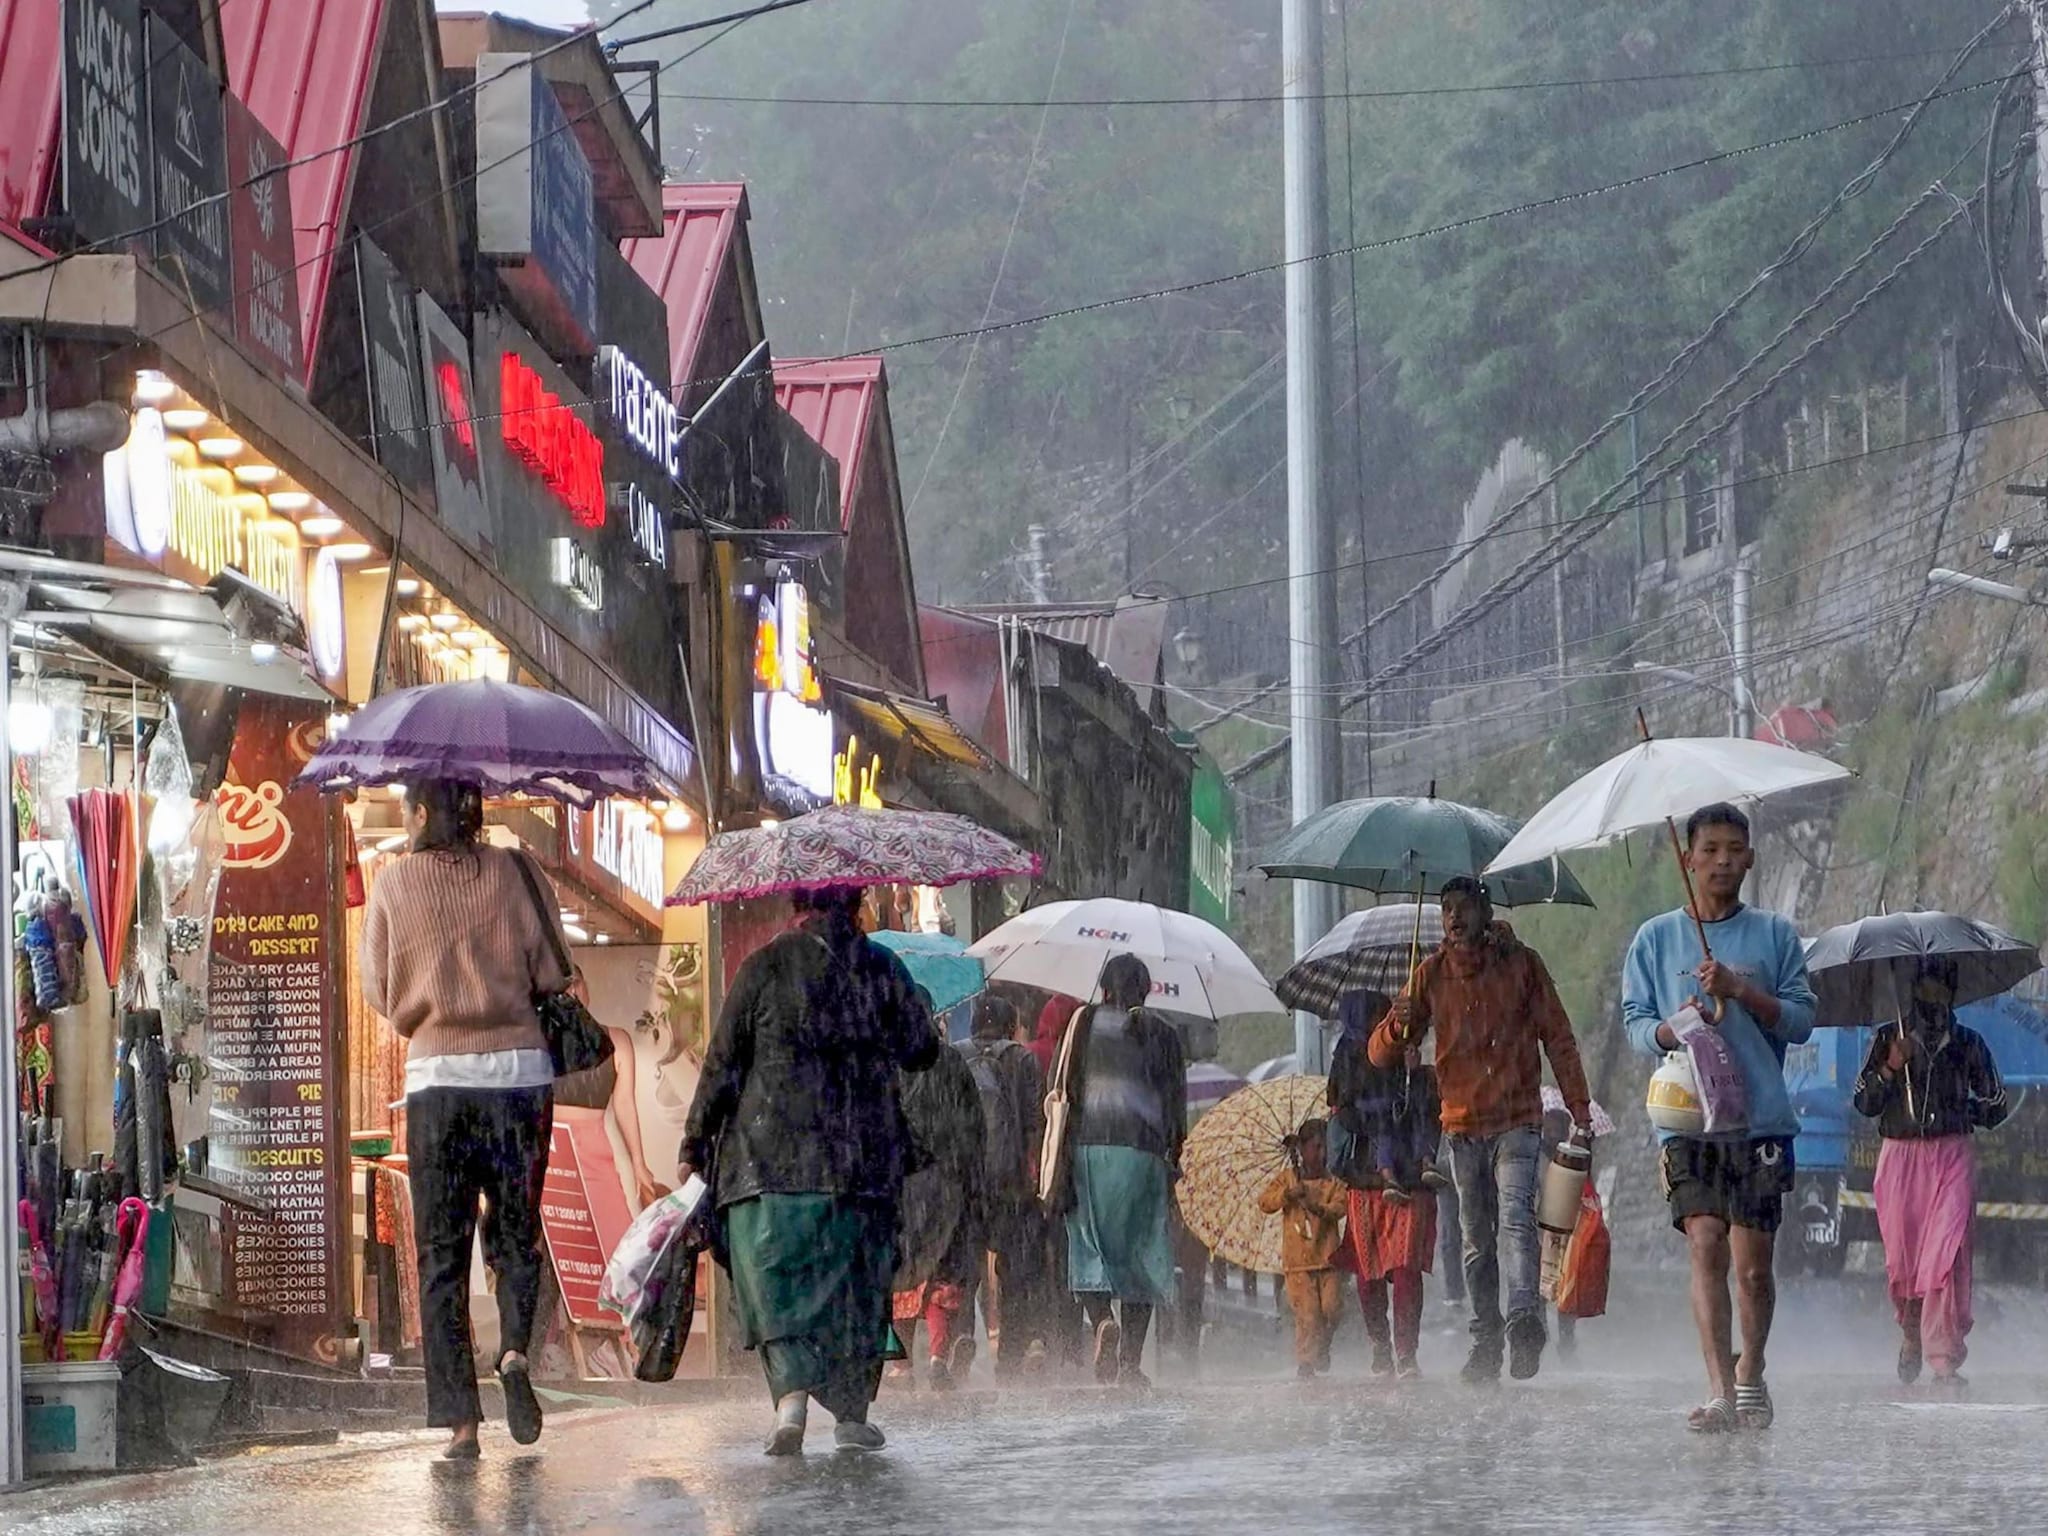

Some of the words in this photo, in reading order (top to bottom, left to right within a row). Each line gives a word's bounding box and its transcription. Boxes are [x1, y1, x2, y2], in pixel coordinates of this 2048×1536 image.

[78, 77, 140, 208] JONES
[160, 154, 192, 233] MONTE
[253, 250, 284, 312] FLYING
[250, 298, 293, 368] MACHINE
[214, 916, 246, 934] DRY
[248, 915, 284, 932] CAKE
[287, 913, 319, 930] AND
[250, 937, 319, 956] DESSERT
[287, 963, 320, 974] CAKE
[287, 976, 320, 987] CAKE
[268, 990, 320, 1001] PSDWON
[268, 1003, 320, 1014] PSDWON
[284, 1016, 320, 1026] MUFIN
[277, 1029, 321, 1040] MUFFIN
[284, 1043, 321, 1053] MUFIN
[280, 1056, 321, 1067] BREAD
[298, 1084, 322, 1100] PIE
[270, 1106, 301, 1117] PPLE
[304, 1105, 323, 1116] PIE
[304, 1119, 323, 1130] PIE
[270, 1133, 309, 1144] TURLE
[312, 1132, 324, 1143] PI
[295, 1170, 324, 1182] CHIP
[280, 1183, 324, 1194] KATHAI
[280, 1197, 324, 1208] KATHAI
[275, 1210, 325, 1221] FRUITTY
